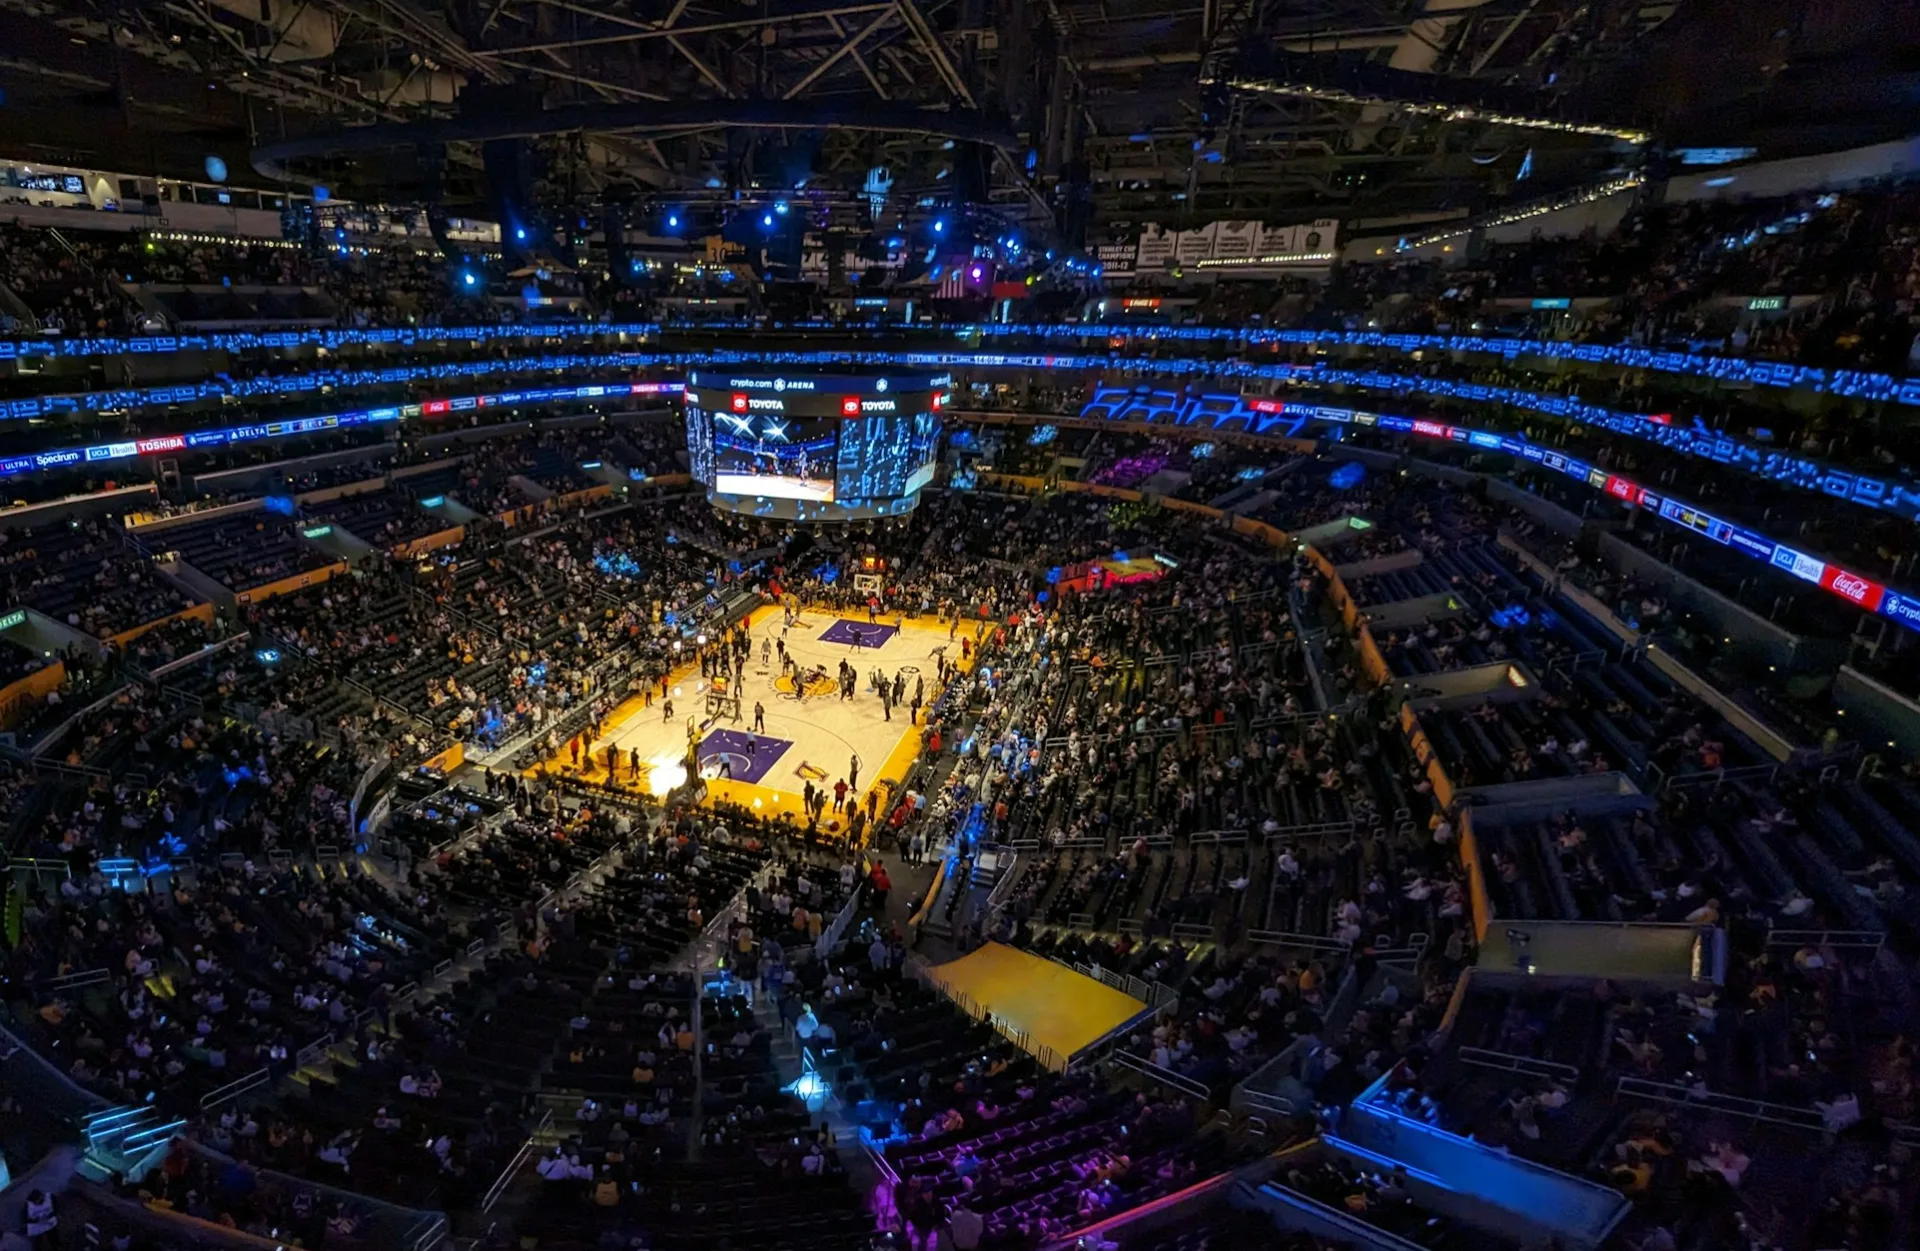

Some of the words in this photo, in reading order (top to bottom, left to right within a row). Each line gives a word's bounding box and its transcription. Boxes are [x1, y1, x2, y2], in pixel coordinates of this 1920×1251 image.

[1103, 261, 1128, 269] 2011-12
[1756, 300, 1779, 308] DELTA
[730, 379, 772, 388] crypto.com
[748, 399, 784, 410] TOYOTA
[861, 401, 896, 410] TOYOTA
[1291, 405, 1314, 415] DELTA
[239, 428, 265, 437] DELTA
[1414, 421, 1441, 435] TOSHIBA
[140, 438, 184, 452] TOSHIBA
[91, 449, 109, 457] UCLA
[112, 445, 135, 455] Health
[36, 452, 79, 466] Spectrum
[5, 460, 29, 470] ULTRA
[1777, 551, 1793, 566] UCLA
[1796, 559, 1819, 578] Health
[1832, 574, 1870, 600] Coca-Cola
